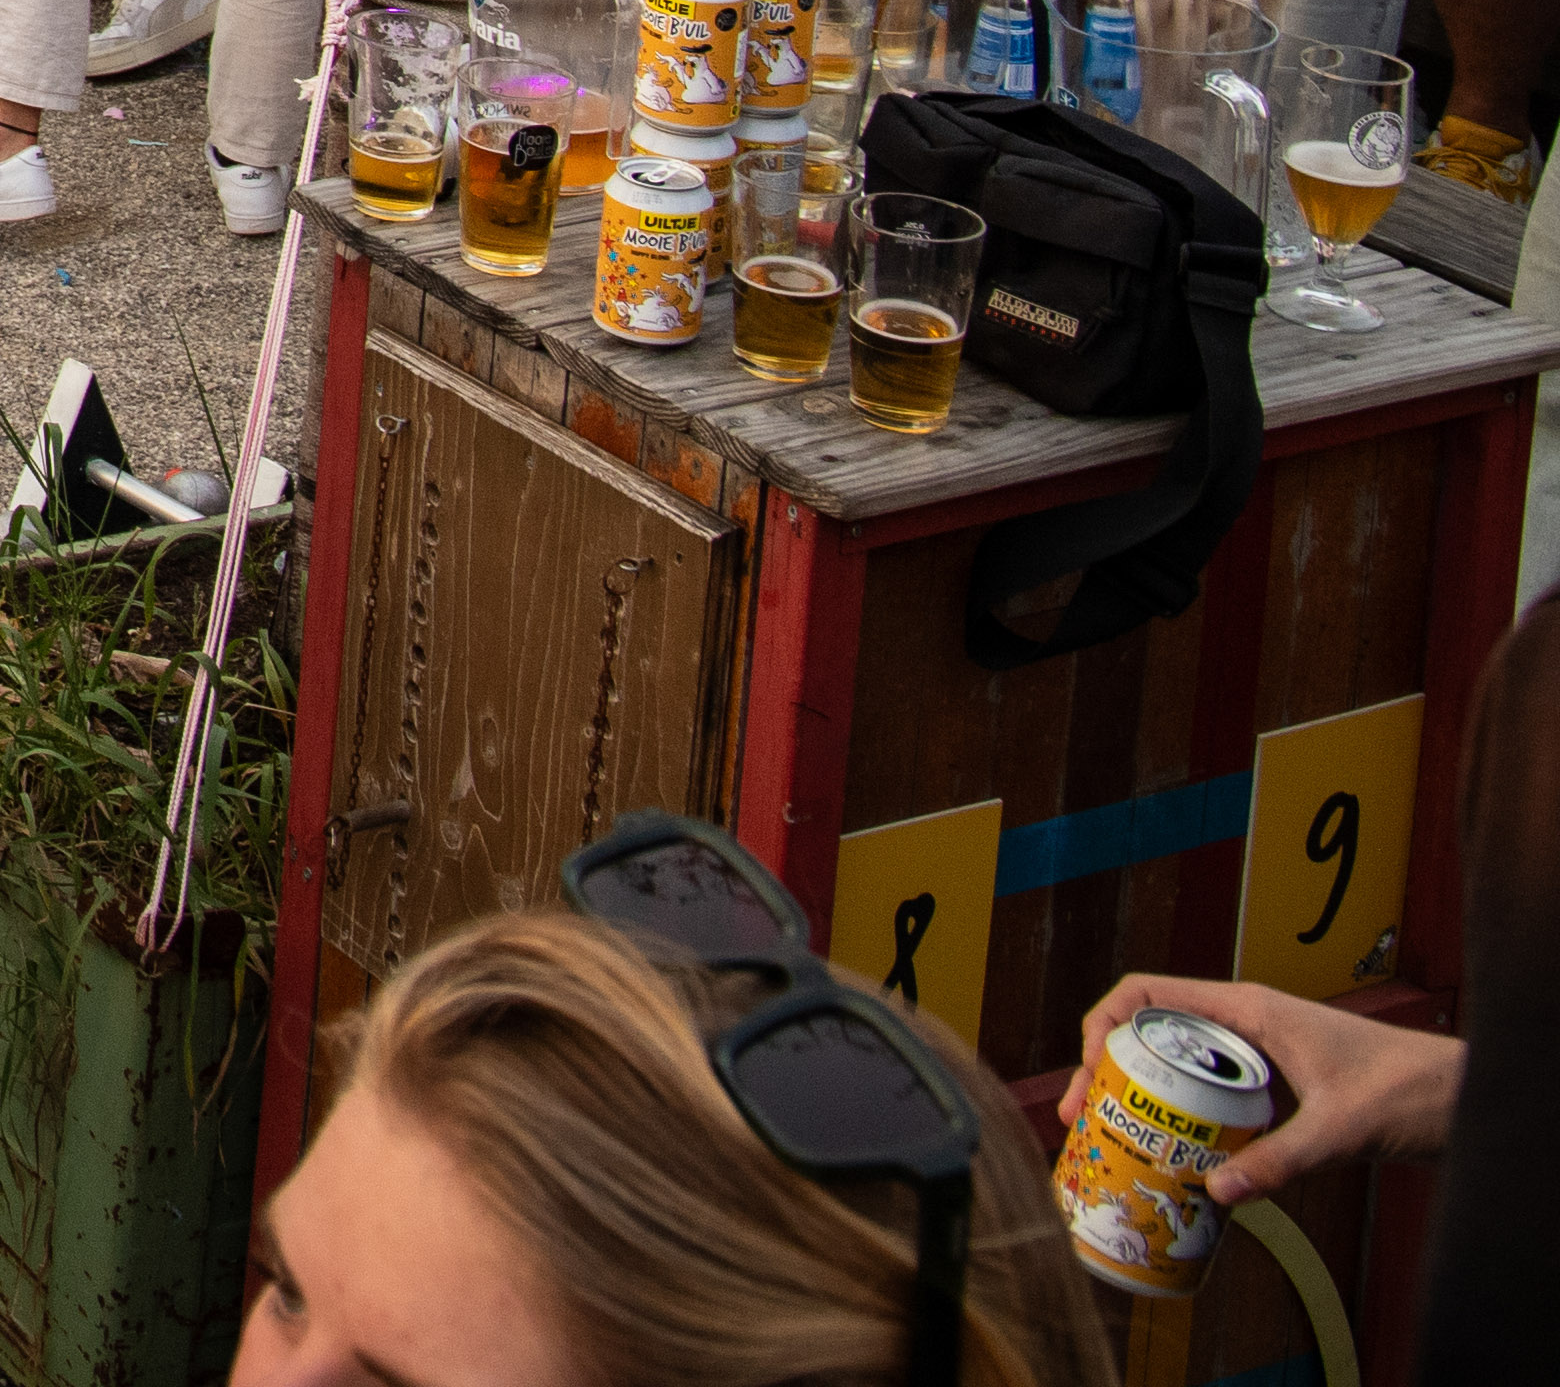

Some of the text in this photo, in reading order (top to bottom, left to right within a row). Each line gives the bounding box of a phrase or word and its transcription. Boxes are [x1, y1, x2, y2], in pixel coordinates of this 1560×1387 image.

[623, 230, 674, 253] MOOIE
[644, 215, 698, 231] UILTJE
[1296, 791, 1361, 945] 9
[1099, 1095, 1166, 1156] MOOIE
[1129, 1090, 1215, 1142] UILTJE
